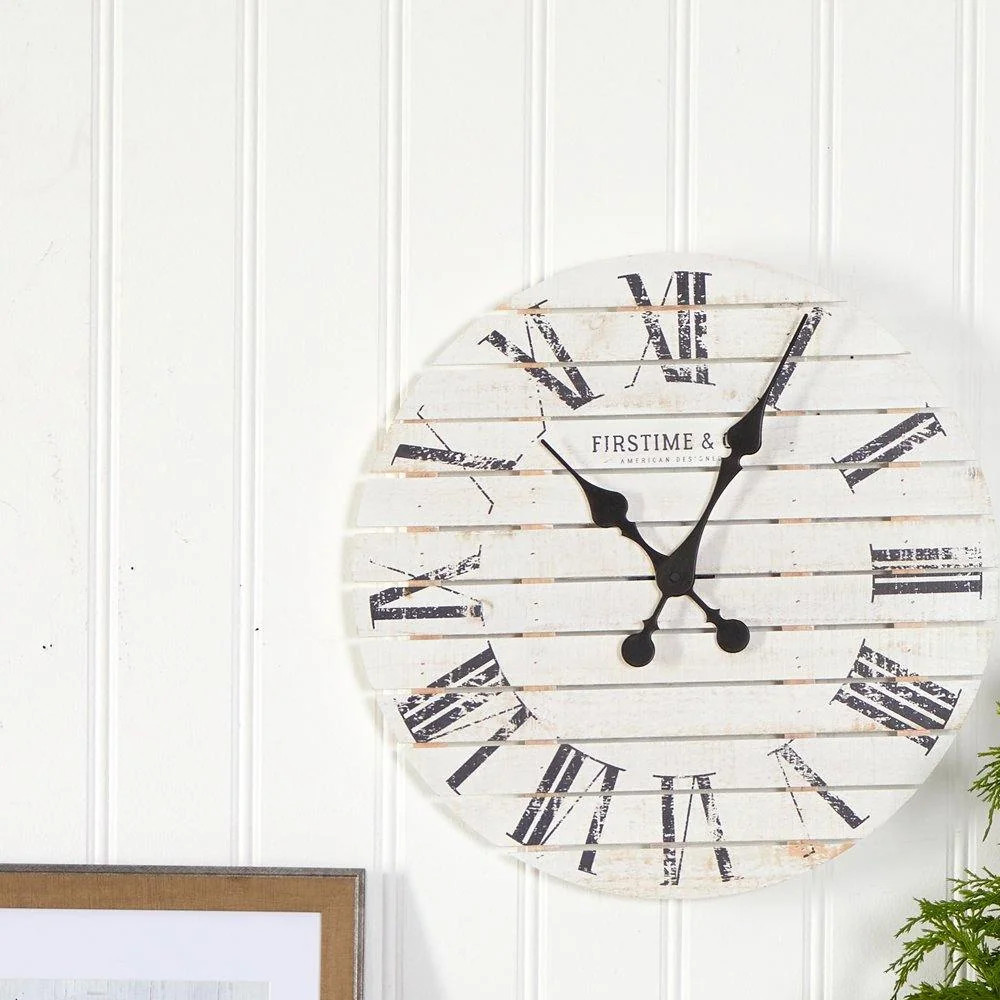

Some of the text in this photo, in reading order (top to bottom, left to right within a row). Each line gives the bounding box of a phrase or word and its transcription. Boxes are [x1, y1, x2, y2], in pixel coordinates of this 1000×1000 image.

[478, 299, 606, 438] XI
[611, 271, 716, 388] XII
[391, 403, 524, 514] X
[592, 433, 694, 453] FIRSTIME
[702, 432, 714, 450] &
[620, 454, 722, 465] AMERICAN DESGNER
[831, 403, 947, 494] II
[369, 544, 486, 629] IX
[869, 541, 984, 603] III
[396, 640, 538, 795] VIII
[829, 638, 963, 756] IIII
[506, 743, 627, 877] VII
[653, 772, 738, 887] VI
[767, 738, 870, 858] V
